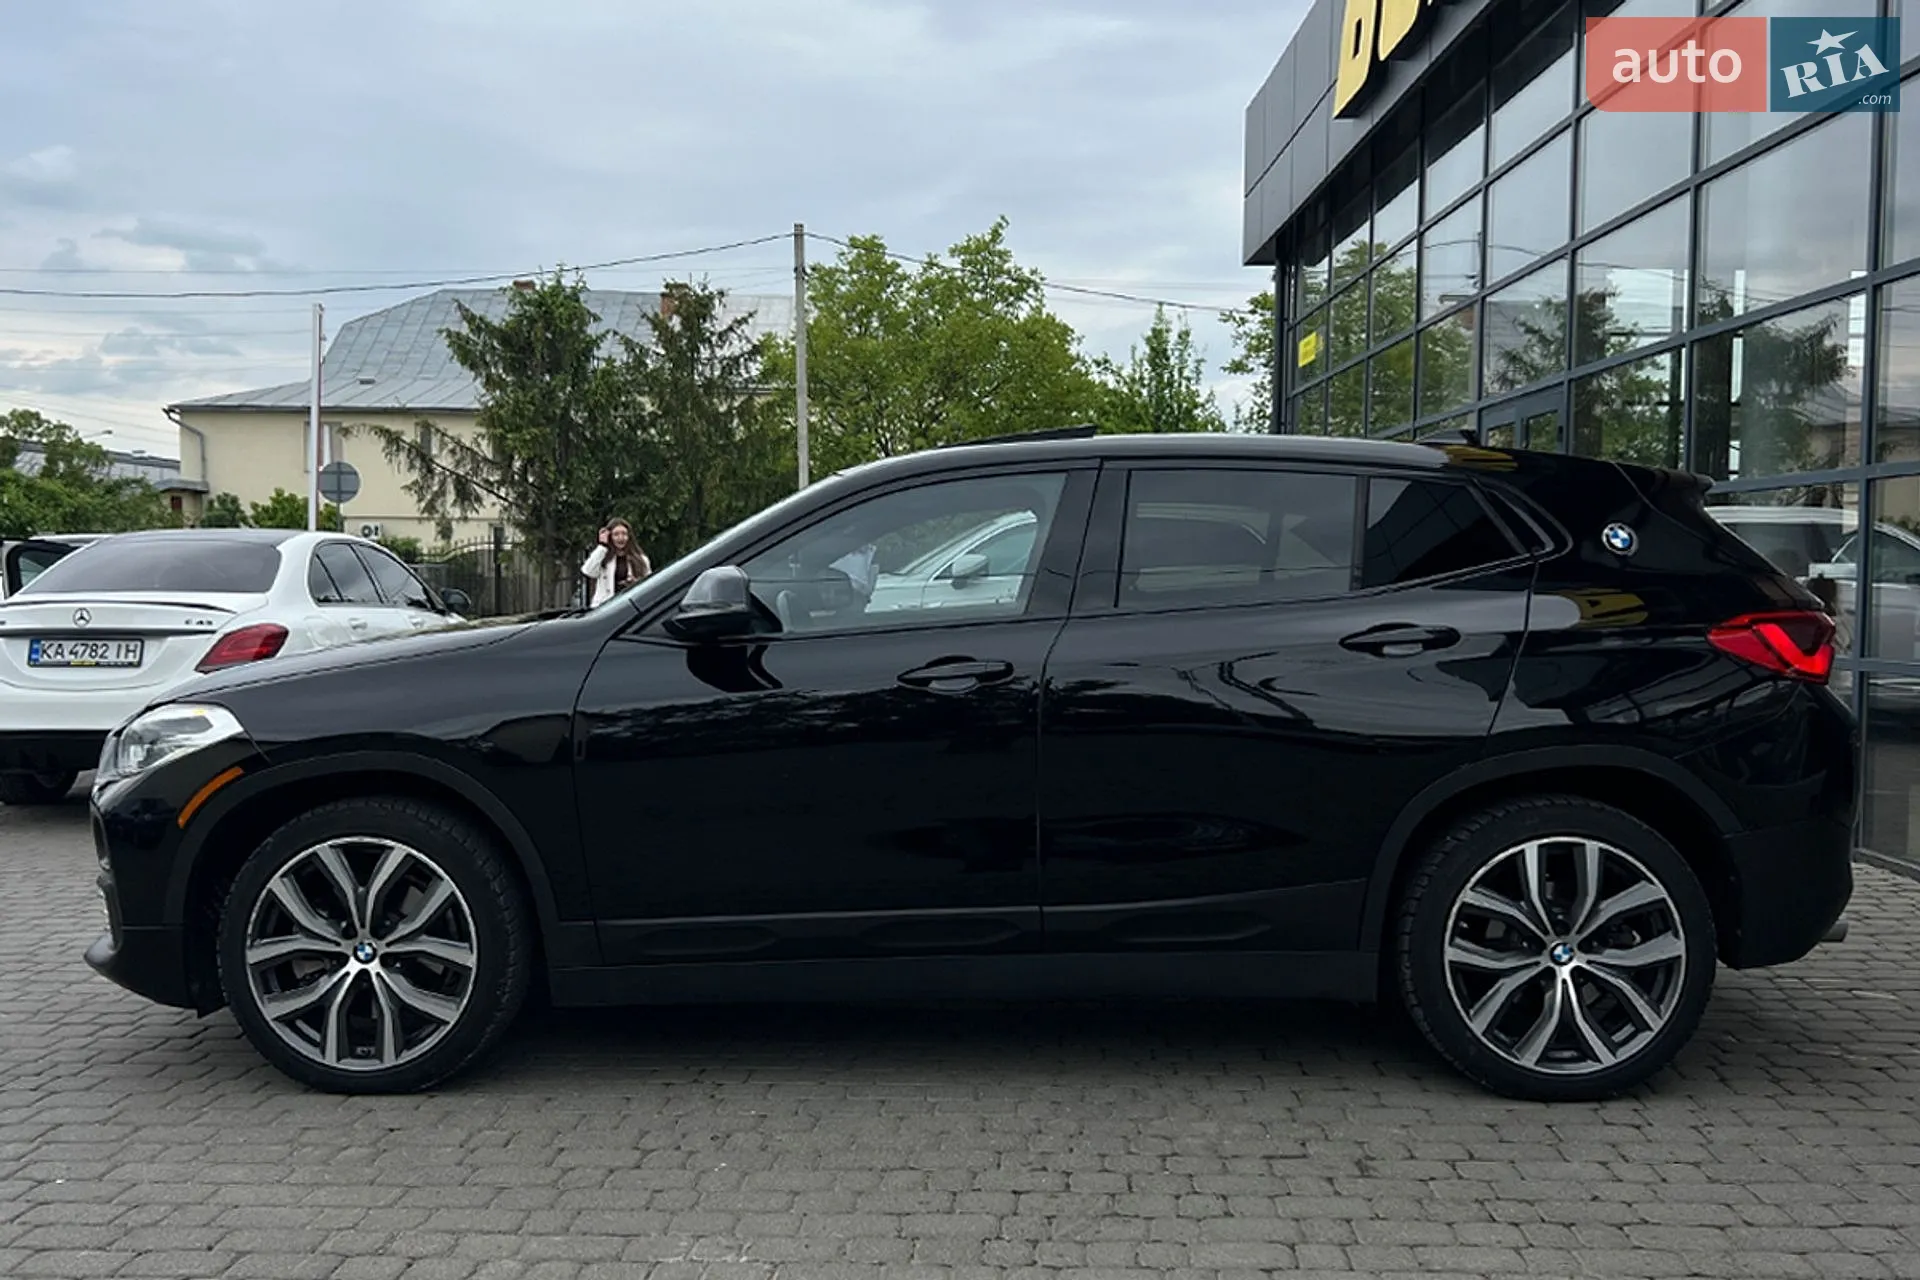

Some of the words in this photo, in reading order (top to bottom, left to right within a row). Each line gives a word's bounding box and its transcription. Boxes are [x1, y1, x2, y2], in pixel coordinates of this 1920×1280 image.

[41, 643, 65, 659] KA
[69, 643, 109, 659] 4782
[116, 643, 138, 659] IH
